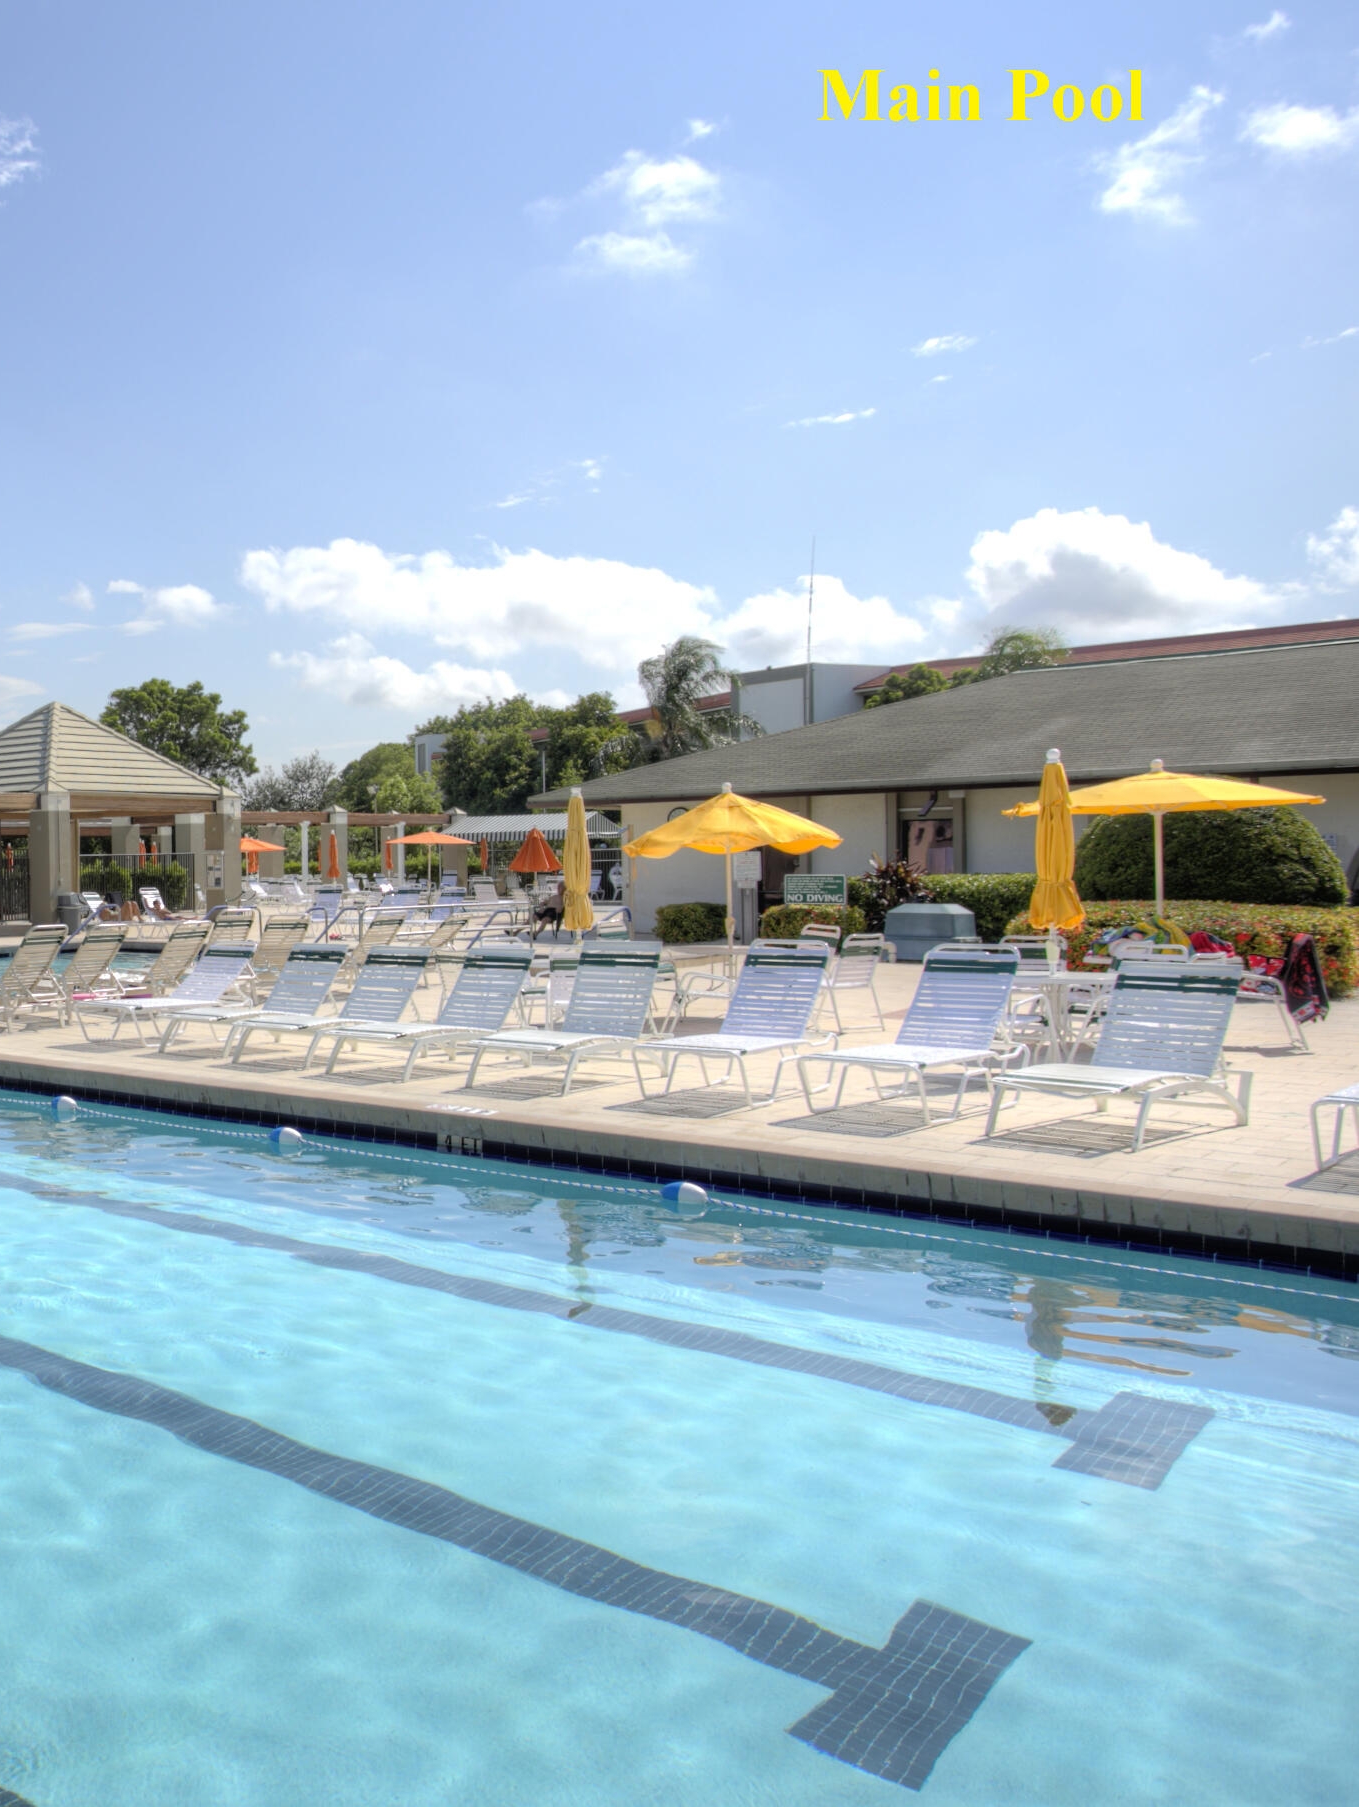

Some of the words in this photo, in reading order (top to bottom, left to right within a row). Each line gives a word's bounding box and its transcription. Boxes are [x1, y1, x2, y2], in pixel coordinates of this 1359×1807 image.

[787, 894, 803, 902] NO
[807, 894, 843, 902] DIVING
[445, 1135, 452, 1150] 4
[461, 1136, 482, 1153] FT
